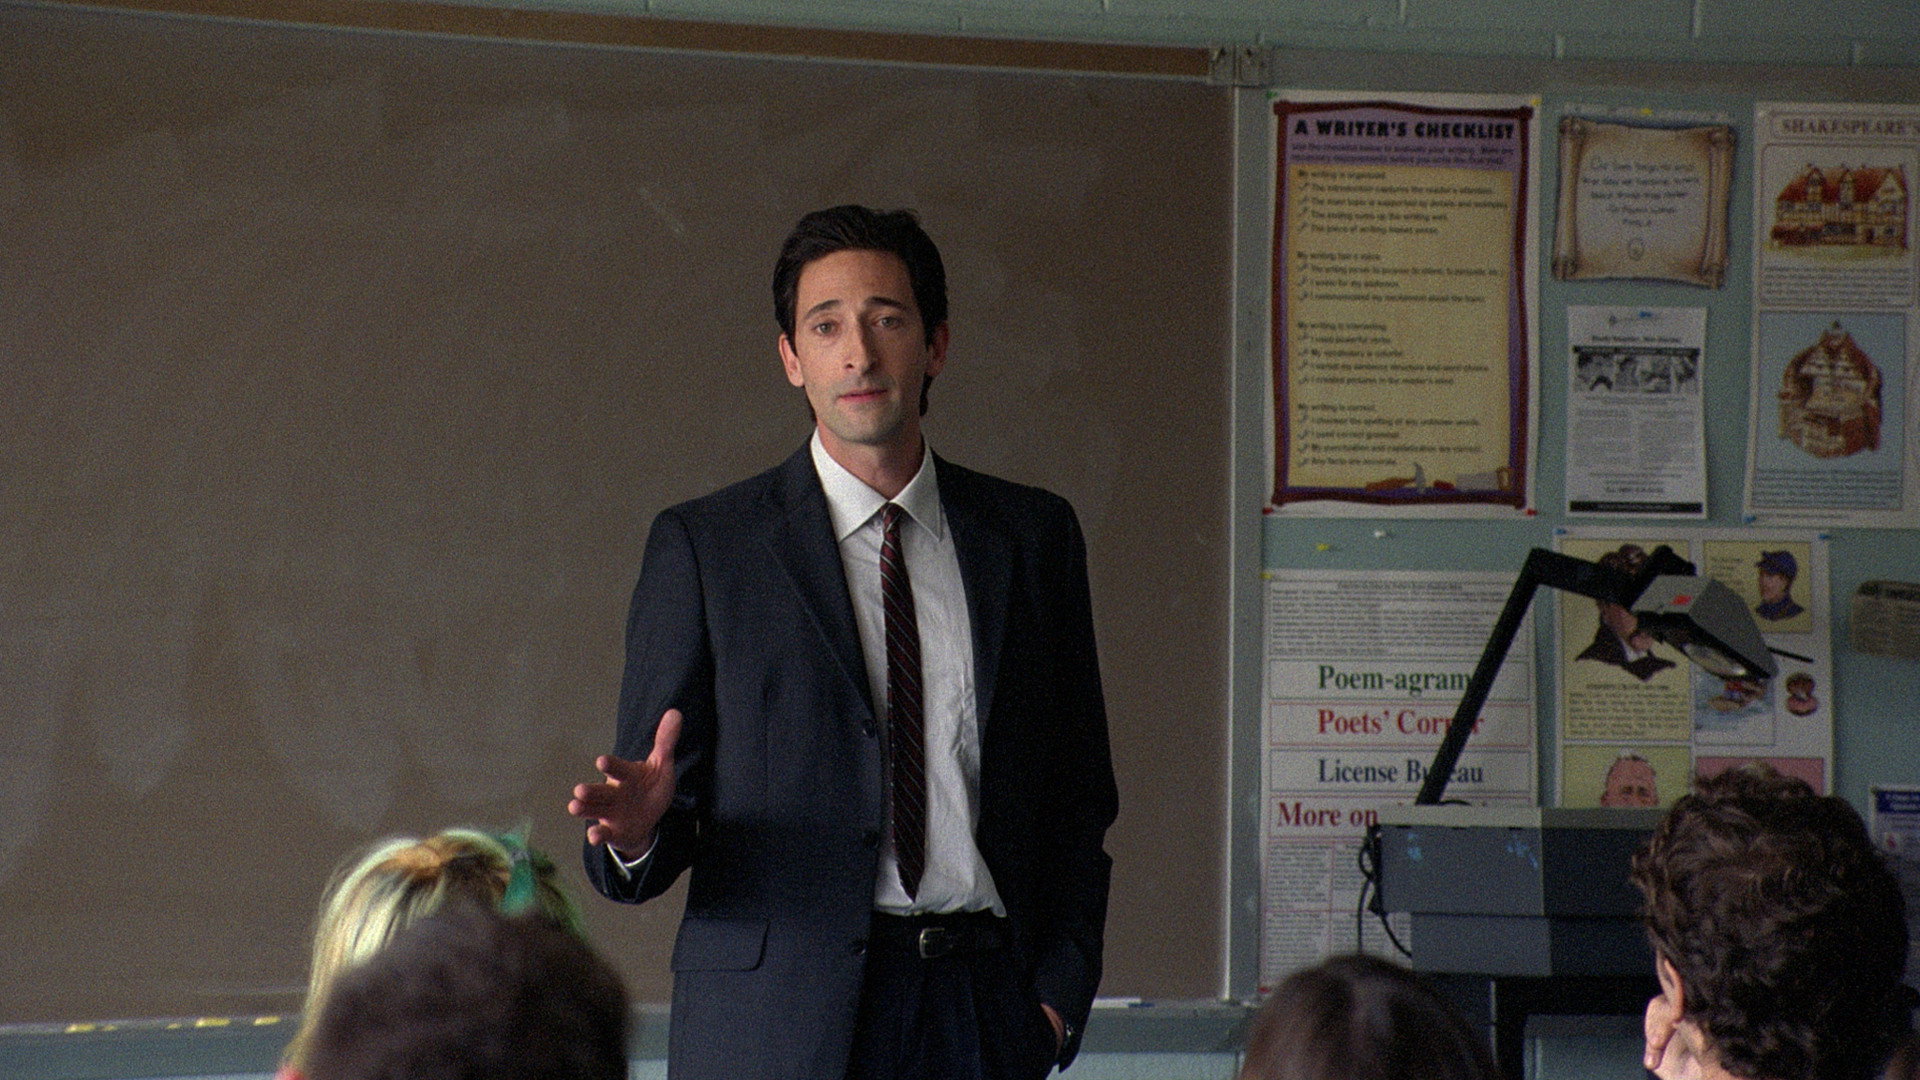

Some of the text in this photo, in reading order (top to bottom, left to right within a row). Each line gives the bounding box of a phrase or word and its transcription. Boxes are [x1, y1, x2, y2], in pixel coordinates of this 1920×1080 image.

[1294, 120, 1514, 139] A WRITER'S CHECKLIST
[1318, 709, 1485, 734] Poets' Cornr
[1318, 759, 1484, 782] License Beau
[1277, 801, 1379, 827] More on
